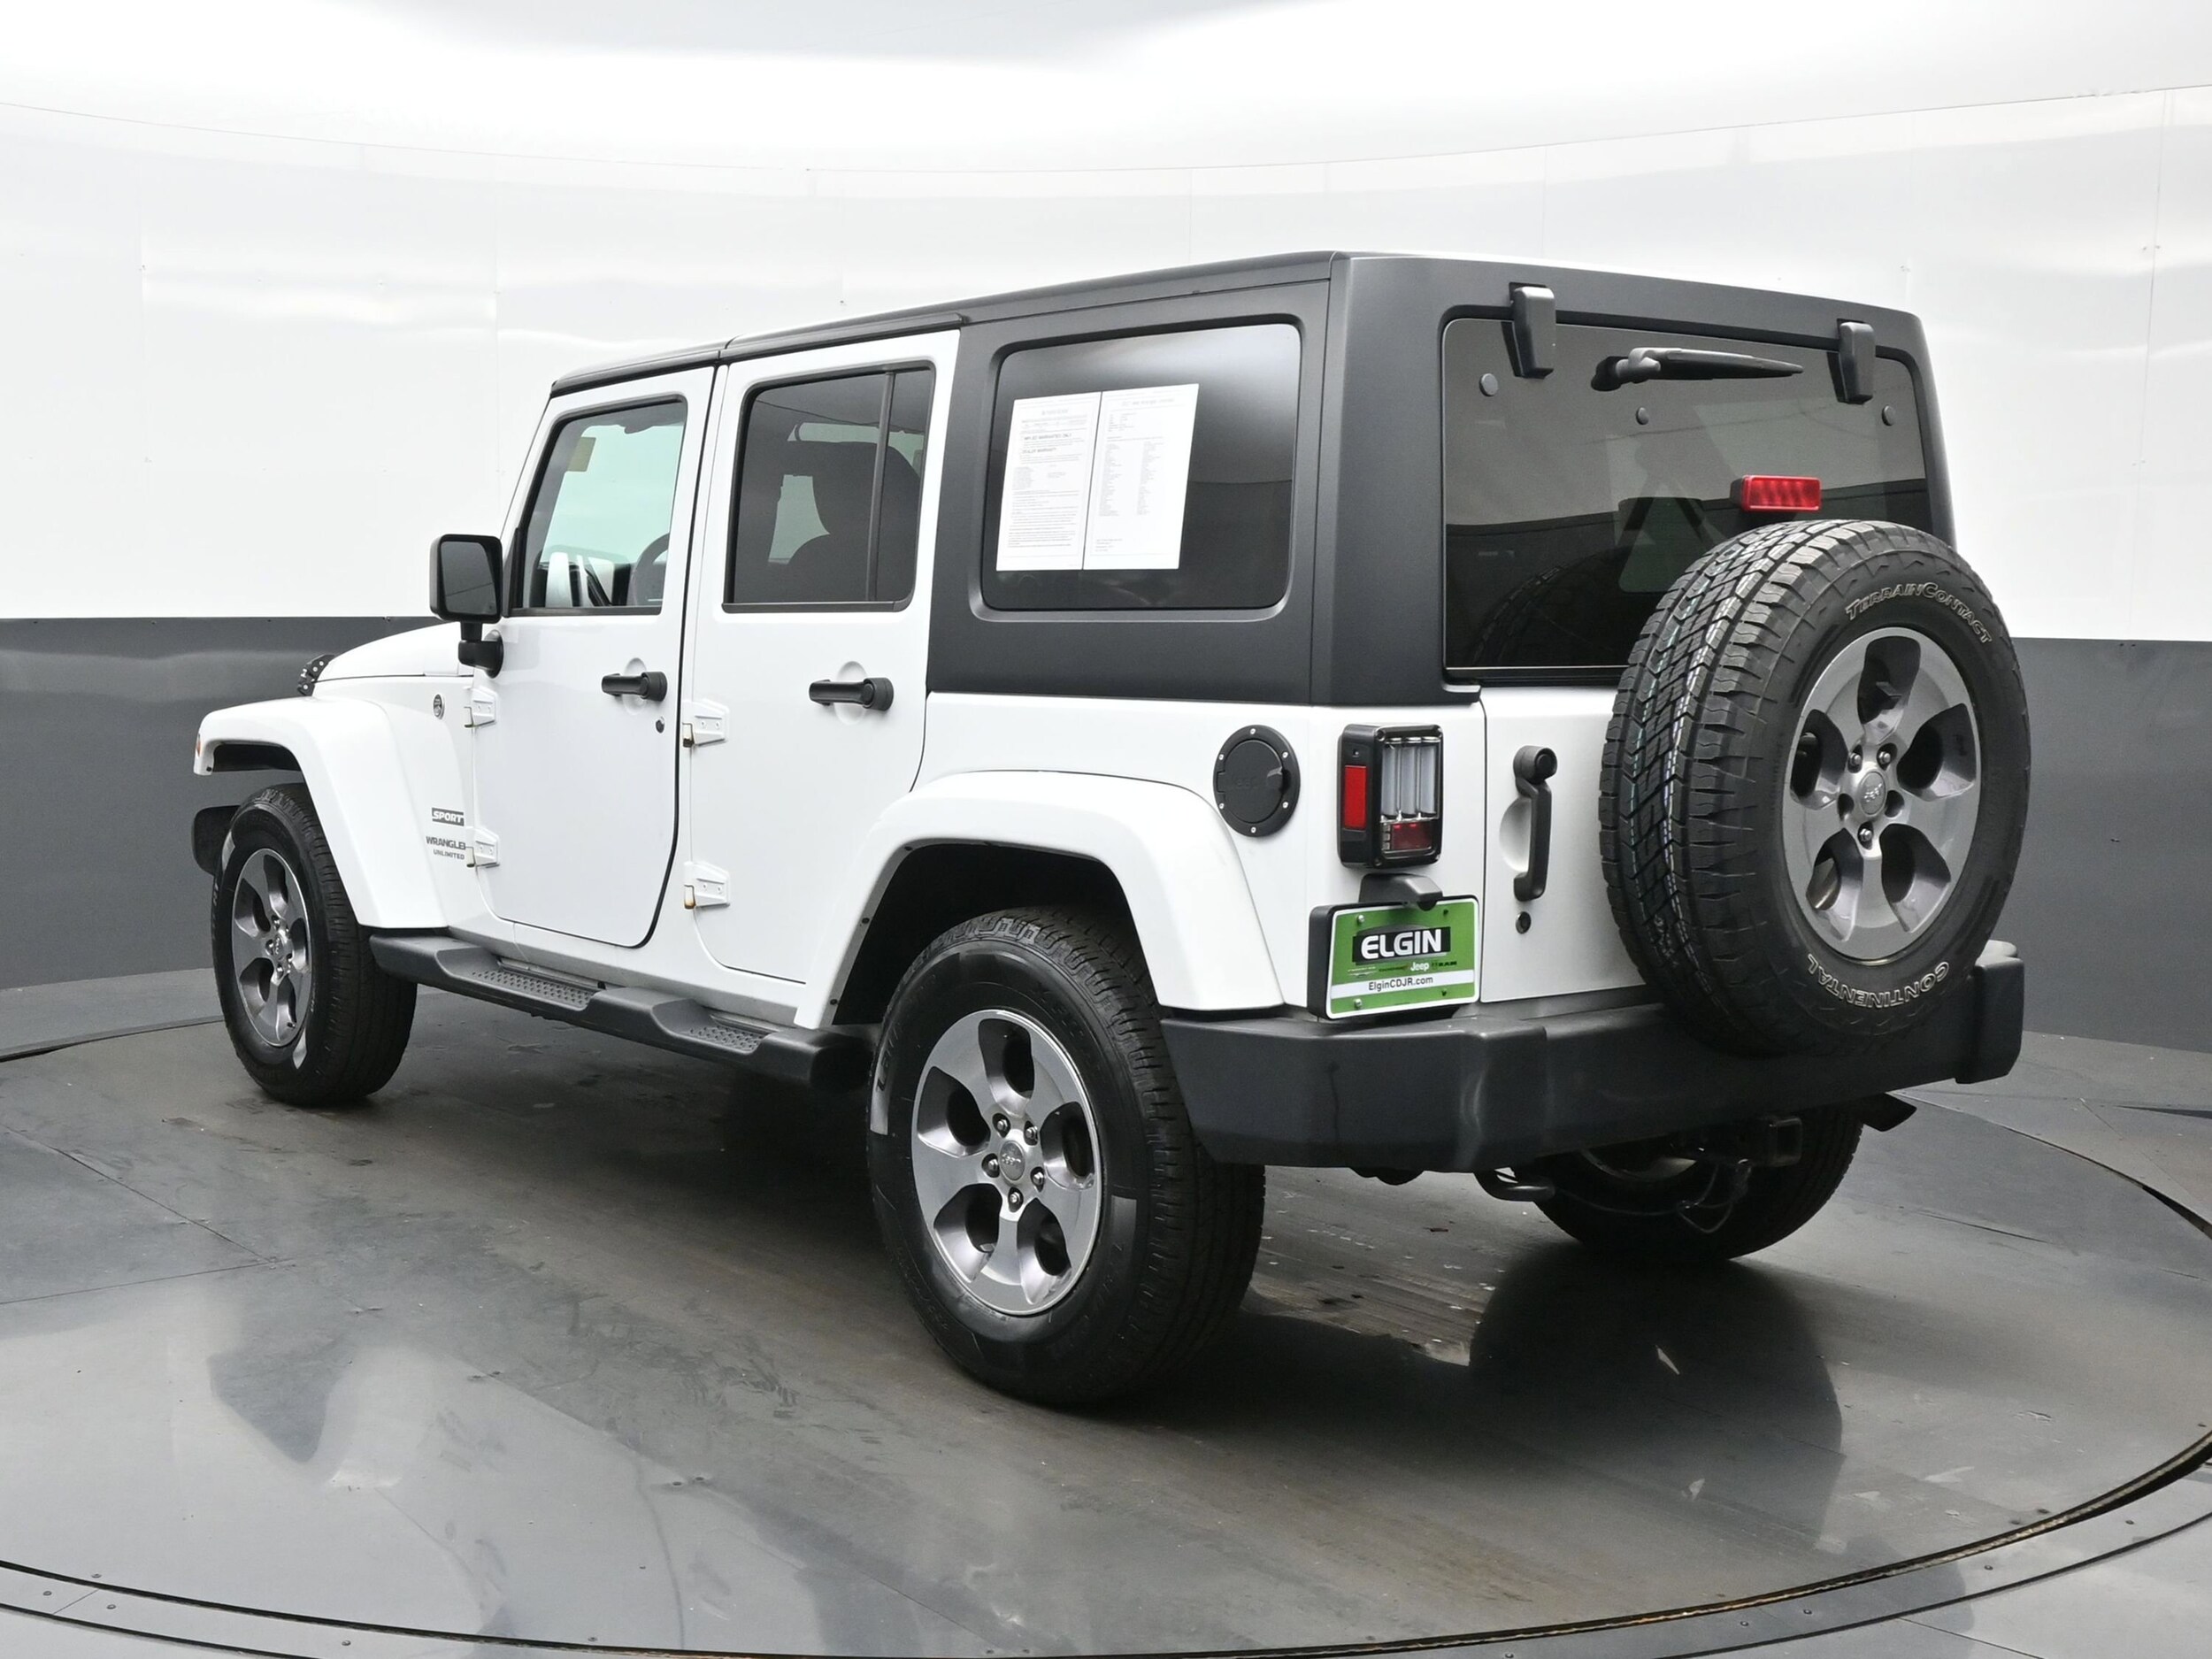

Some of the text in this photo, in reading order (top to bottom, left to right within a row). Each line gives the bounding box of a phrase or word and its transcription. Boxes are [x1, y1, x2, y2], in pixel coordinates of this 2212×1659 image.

[432, 809, 465, 825] SPORT
[426, 835, 466, 849] WRANGLE
[433, 849, 465, 859] UNLIMITED
[1361, 929, 1441, 960] ELGIN
[1410, 961, 1430, 972] Jeep
[1368, 977, 1433, 992] ElginCDJR.com
[1808, 953, 1950, 1009] CONTINENTAL
